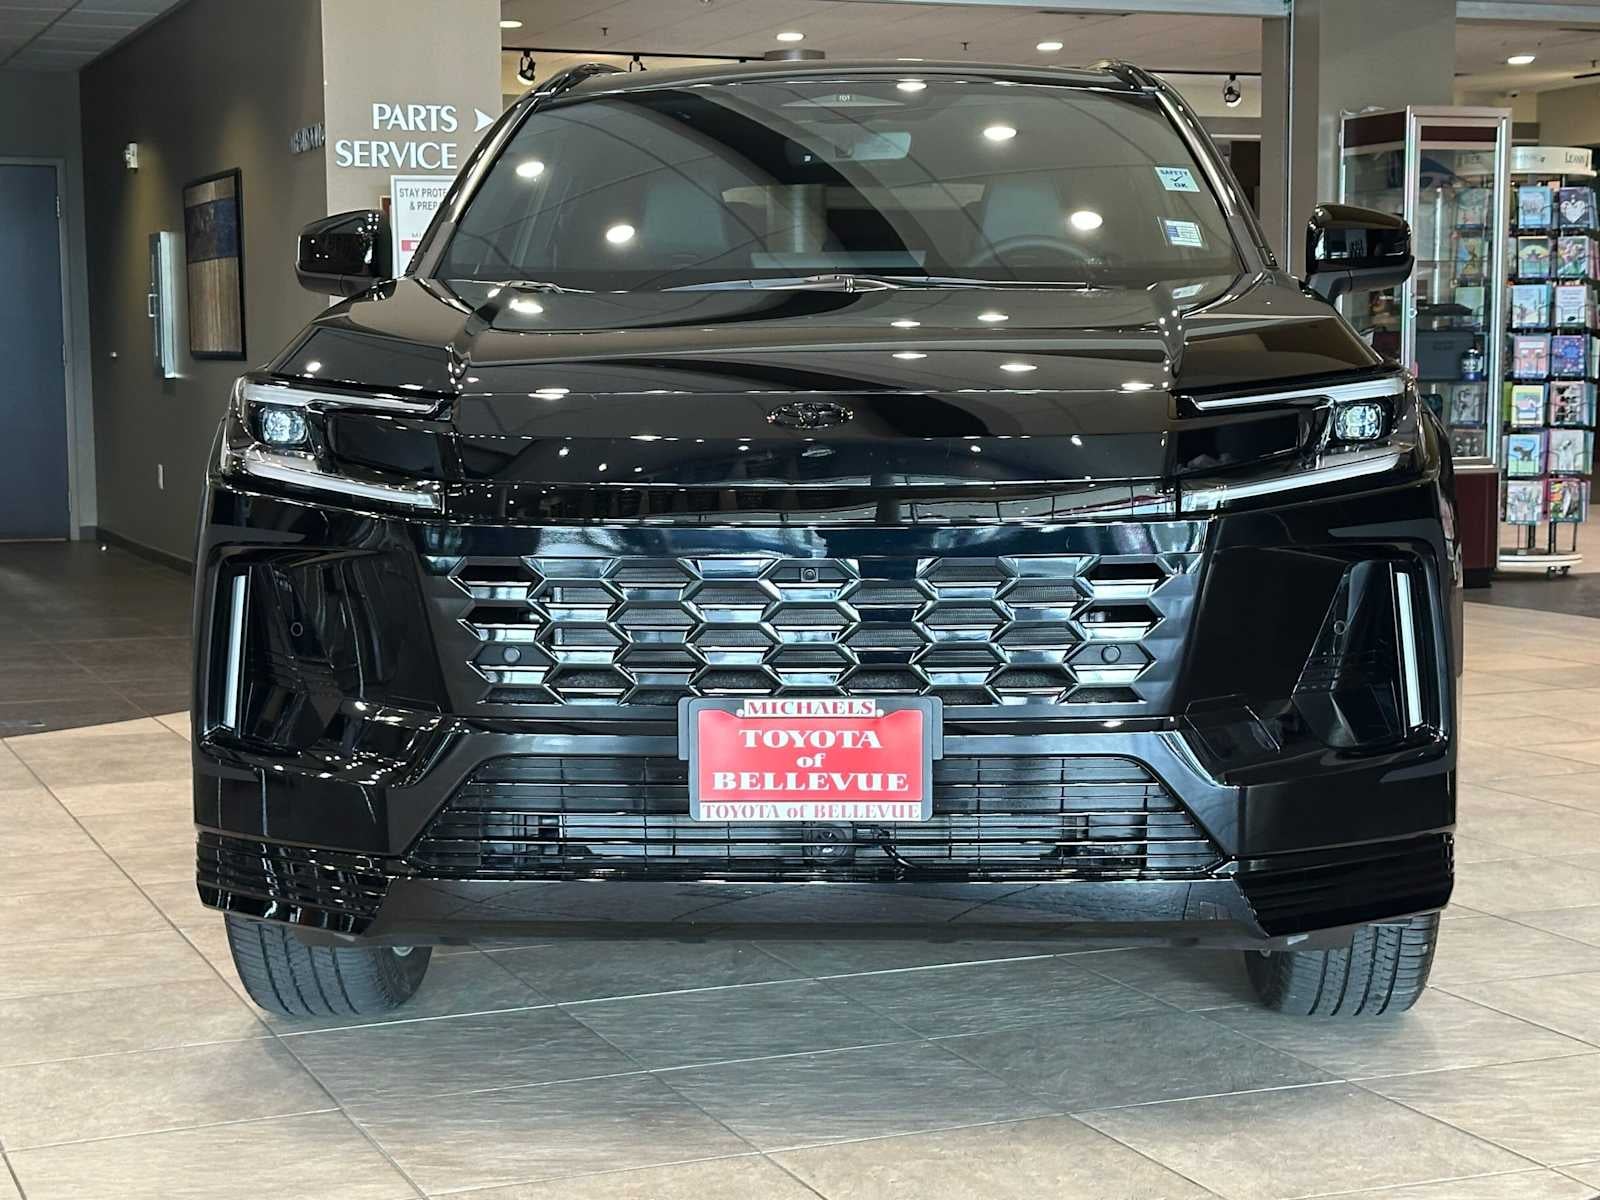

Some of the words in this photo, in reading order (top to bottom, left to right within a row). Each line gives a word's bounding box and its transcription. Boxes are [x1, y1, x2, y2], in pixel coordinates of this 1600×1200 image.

[372, 103, 458, 131] PARTS
[335, 139, 457, 169] SERVICE
[399, 188, 419, 198] STAY
[748, 701, 873, 715] MICHAELS
[739, 729, 883, 749] TOYOTA
[796, 753, 826, 768] of
[712, 772, 909, 792] BELLEVUE
[702, 804, 780, 818] TOYOTA
[787, 804, 807, 818] of
[815, 804, 920, 818] BELLEVUE
